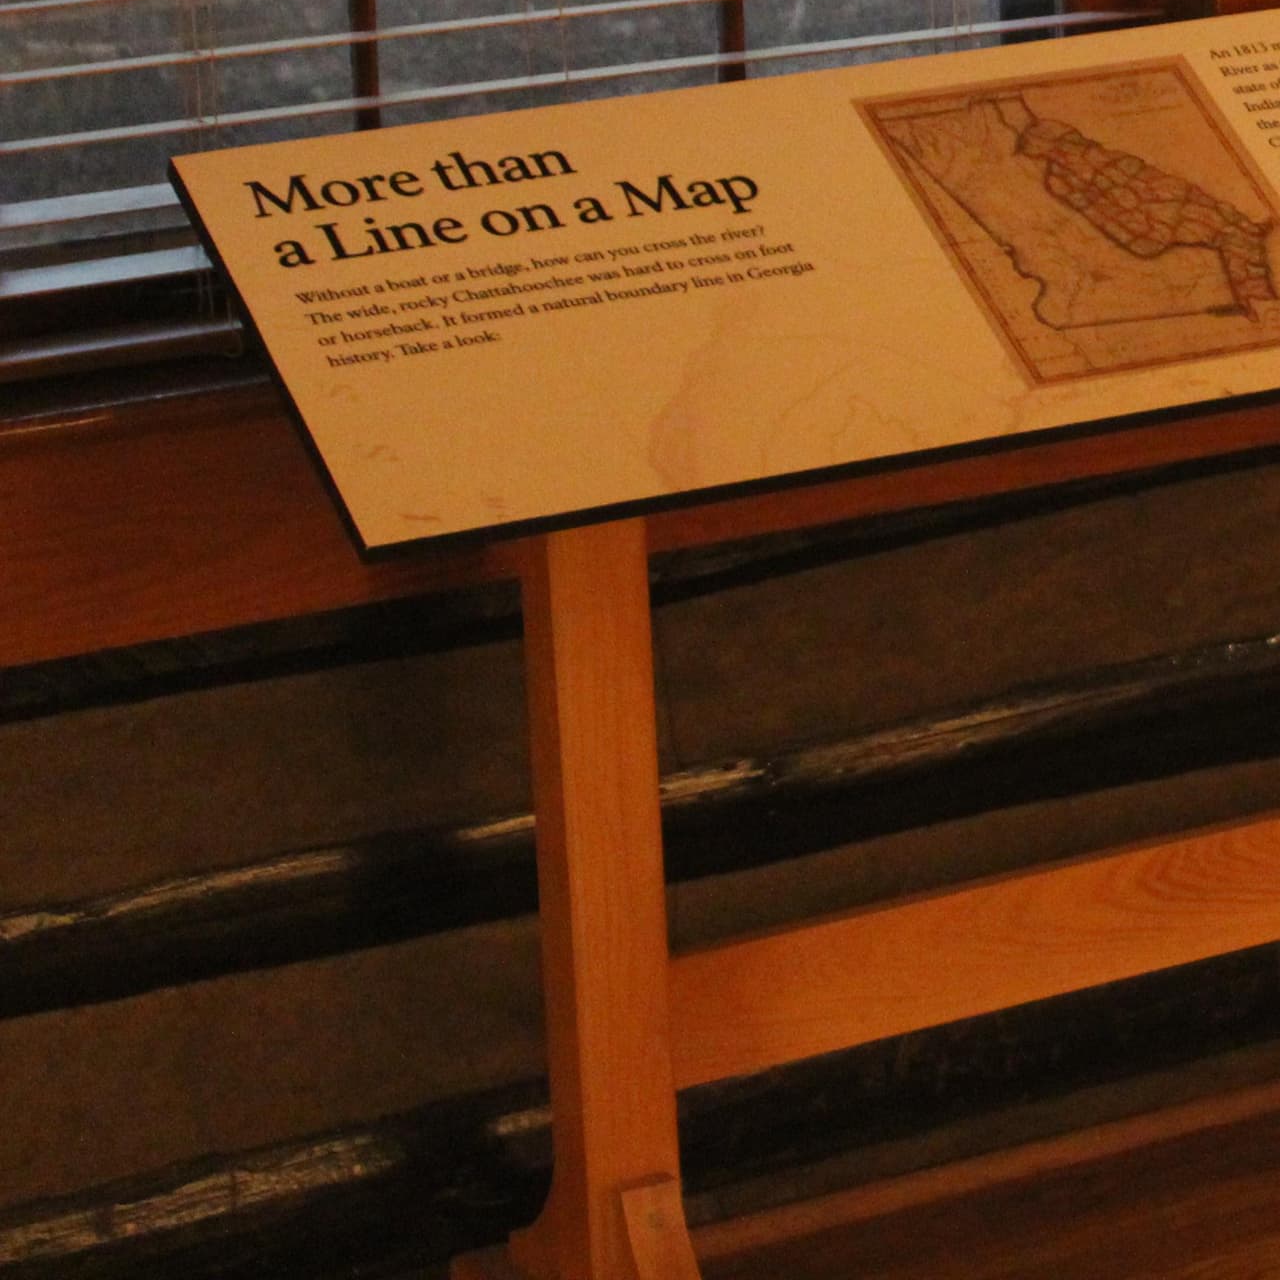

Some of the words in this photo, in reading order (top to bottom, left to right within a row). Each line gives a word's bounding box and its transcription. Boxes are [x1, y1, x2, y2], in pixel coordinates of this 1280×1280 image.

[1209, 49, 1231, 59] An
[1232, 42, 1268, 56] 1813
[1218, 65, 1258, 77] River
[1262, 62, 1279, 71] as
[1232, 83, 1266, 94] state
[1255, 119, 1280, 129] the
[242, 169, 425, 219] More
[429, 149, 578, 192] than
[272, 238, 317, 269] a
[313, 216, 469, 261] Line
[479, 202, 567, 237] on
[571, 195, 614, 225] a
[612, 173, 759, 218] Map
[294, 285, 370, 304] Without
[373, 283, 385, 293] a
[384, 276, 428, 291] boat
[430, 273, 450, 284] or
[454, 271, 466, 281] a
[466, 263, 530, 278] bridge,
[530, 256, 569, 269] how
[573, 250, 605, 263] can
[606, 245, 640, 261] you
[642, 239, 687, 252] cross
[688, 233, 716, 245] the
[720, 224, 764, 241] river?
[304, 311, 342, 325] The
[345, 303, 397, 318] wide,
[398, 295, 448, 311] rocky
[451, 276, 583, 302] Chattahoochee
[586, 270, 621, 282] was
[621, 260, 664, 277] hard
[665, 260, 684, 270] to
[687, 253, 731, 267] cross
[733, 249, 757, 260] on
[758, 242, 794, 256] foot
[317, 335, 336, 346] or
[340, 318, 439, 342] horseback.
[441, 314, 457, 327] It
[459, 303, 525, 323] formed
[527, 304, 540, 314] a
[541, 291, 604, 311] natural
[603, 281, 688, 301] boundary
[690, 276, 724, 288] line
[725, 272, 744, 283] in
[746, 261, 814, 279] Georgia
[325, 350, 394, 367] history.
[394, 341, 438, 355] Take
[441, 340, 454, 349] a
